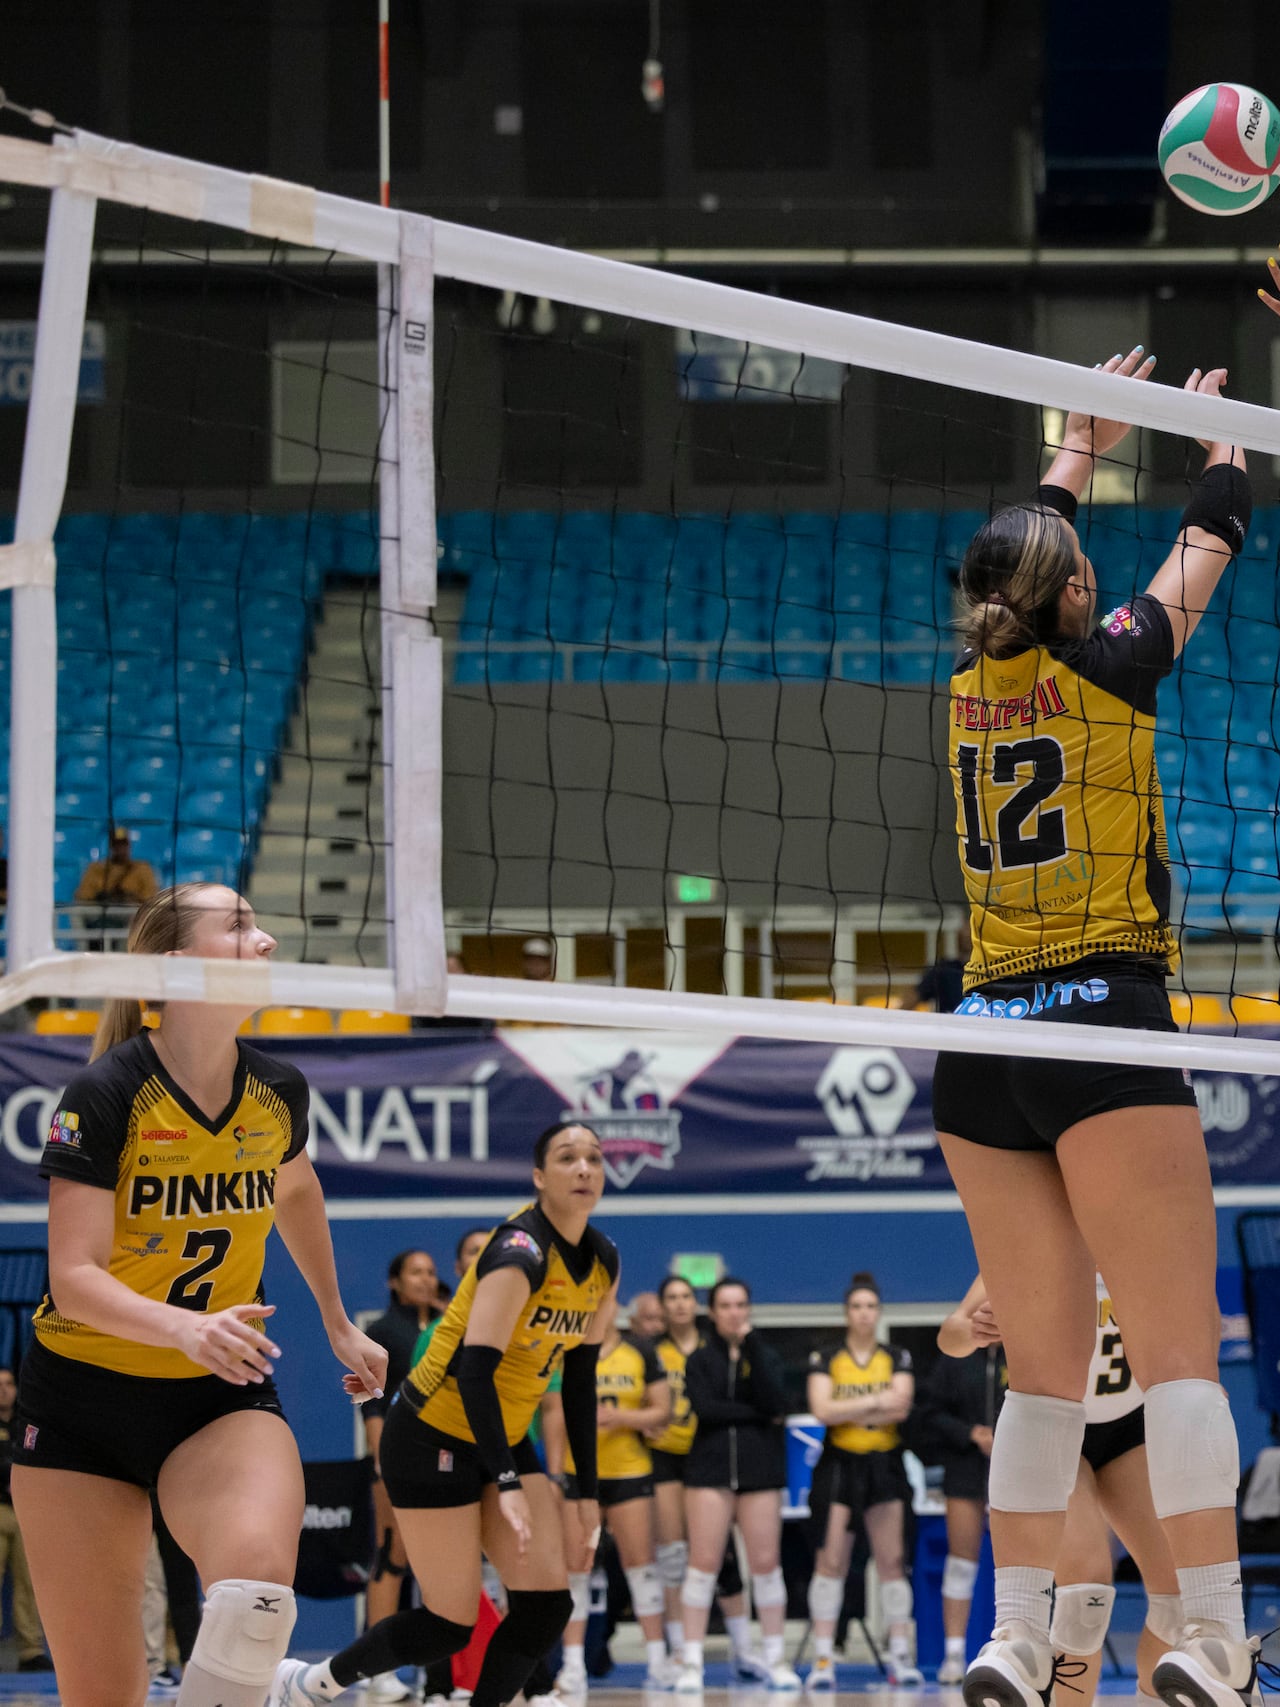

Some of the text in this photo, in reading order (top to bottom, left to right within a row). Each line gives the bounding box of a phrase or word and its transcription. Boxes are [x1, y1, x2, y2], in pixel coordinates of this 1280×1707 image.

[955, 690, 1036, 731] FELIPE
[957, 734, 1068, 874] 12
[306, 1059, 500, 1162] NATÍ
[153, 1154, 191, 1164] TALAVERA
[130, 1168, 278, 1217] PINKIN
[165, 1227, 232, 1312] 2
[1095, 1333, 1132, 1396] 3
